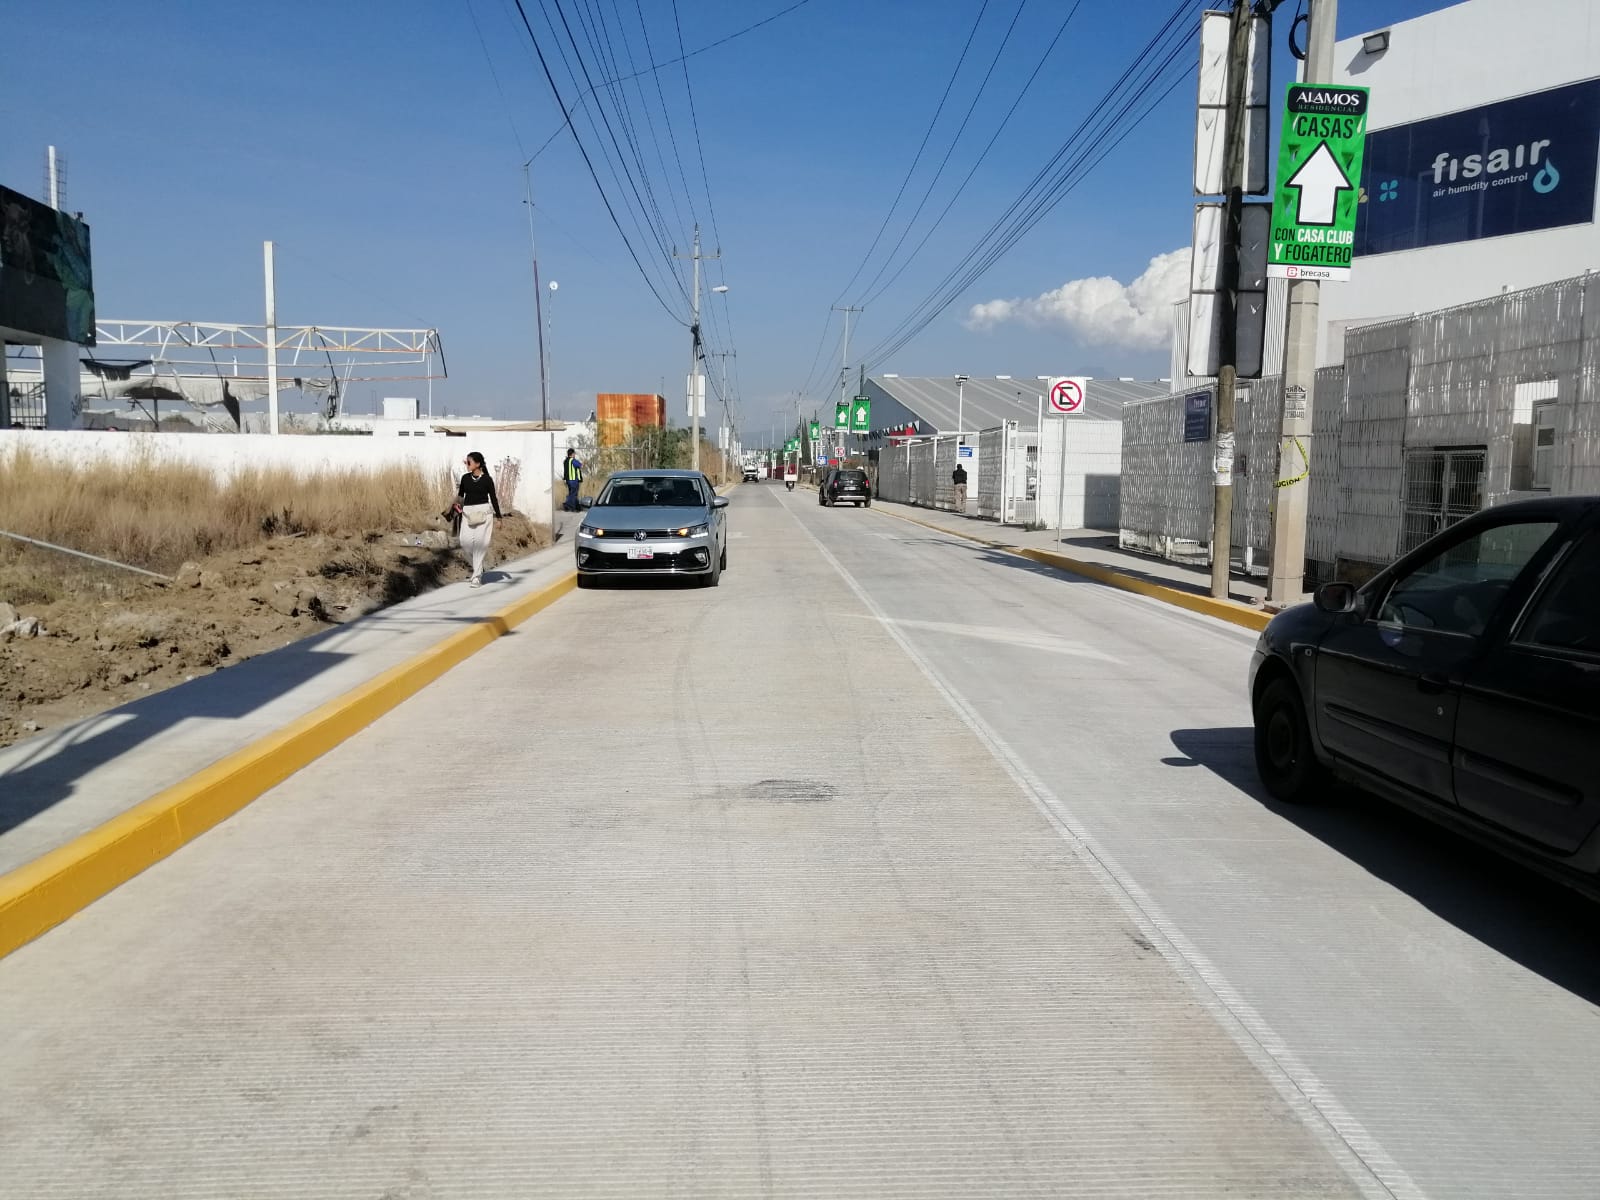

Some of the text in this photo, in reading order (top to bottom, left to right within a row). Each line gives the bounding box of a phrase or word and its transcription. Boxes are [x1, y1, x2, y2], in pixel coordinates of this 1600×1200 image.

[1296, 91, 1360, 106] ALAMOS
[1297, 115, 1354, 139] CASAS
[1432, 139, 1550, 184] fisair
[1432, 172, 1528, 198] air humidity control
[1275, 227, 1354, 245] CON CASA CLUB
[1274, 242, 1352, 264] Y FOGATERO
[1300, 269, 1330, 278] brecasa
